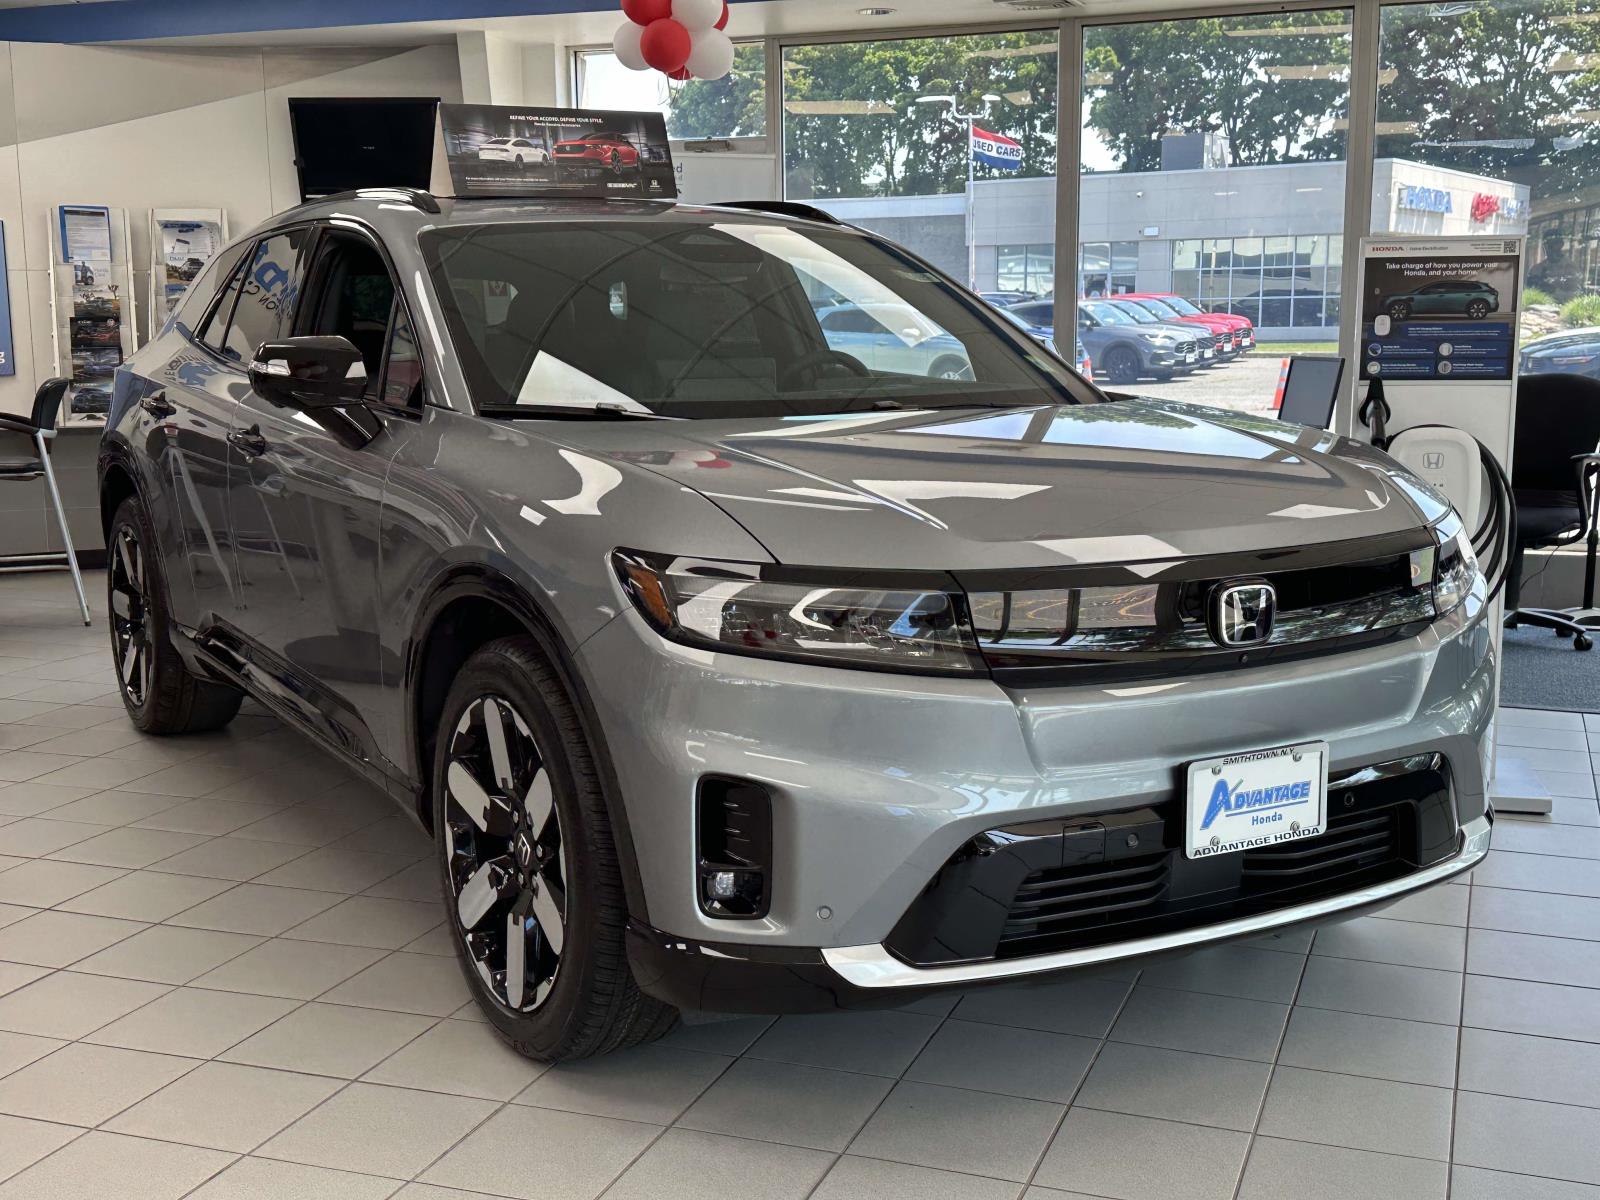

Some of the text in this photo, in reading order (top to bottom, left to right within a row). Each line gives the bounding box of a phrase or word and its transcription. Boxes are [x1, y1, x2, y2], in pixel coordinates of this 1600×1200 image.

[996, 146, 1021, 158] CARS
[1252, 812, 1283, 826] Honda
[1193, 827, 1320, 857] ADVANTAGE HONDA
